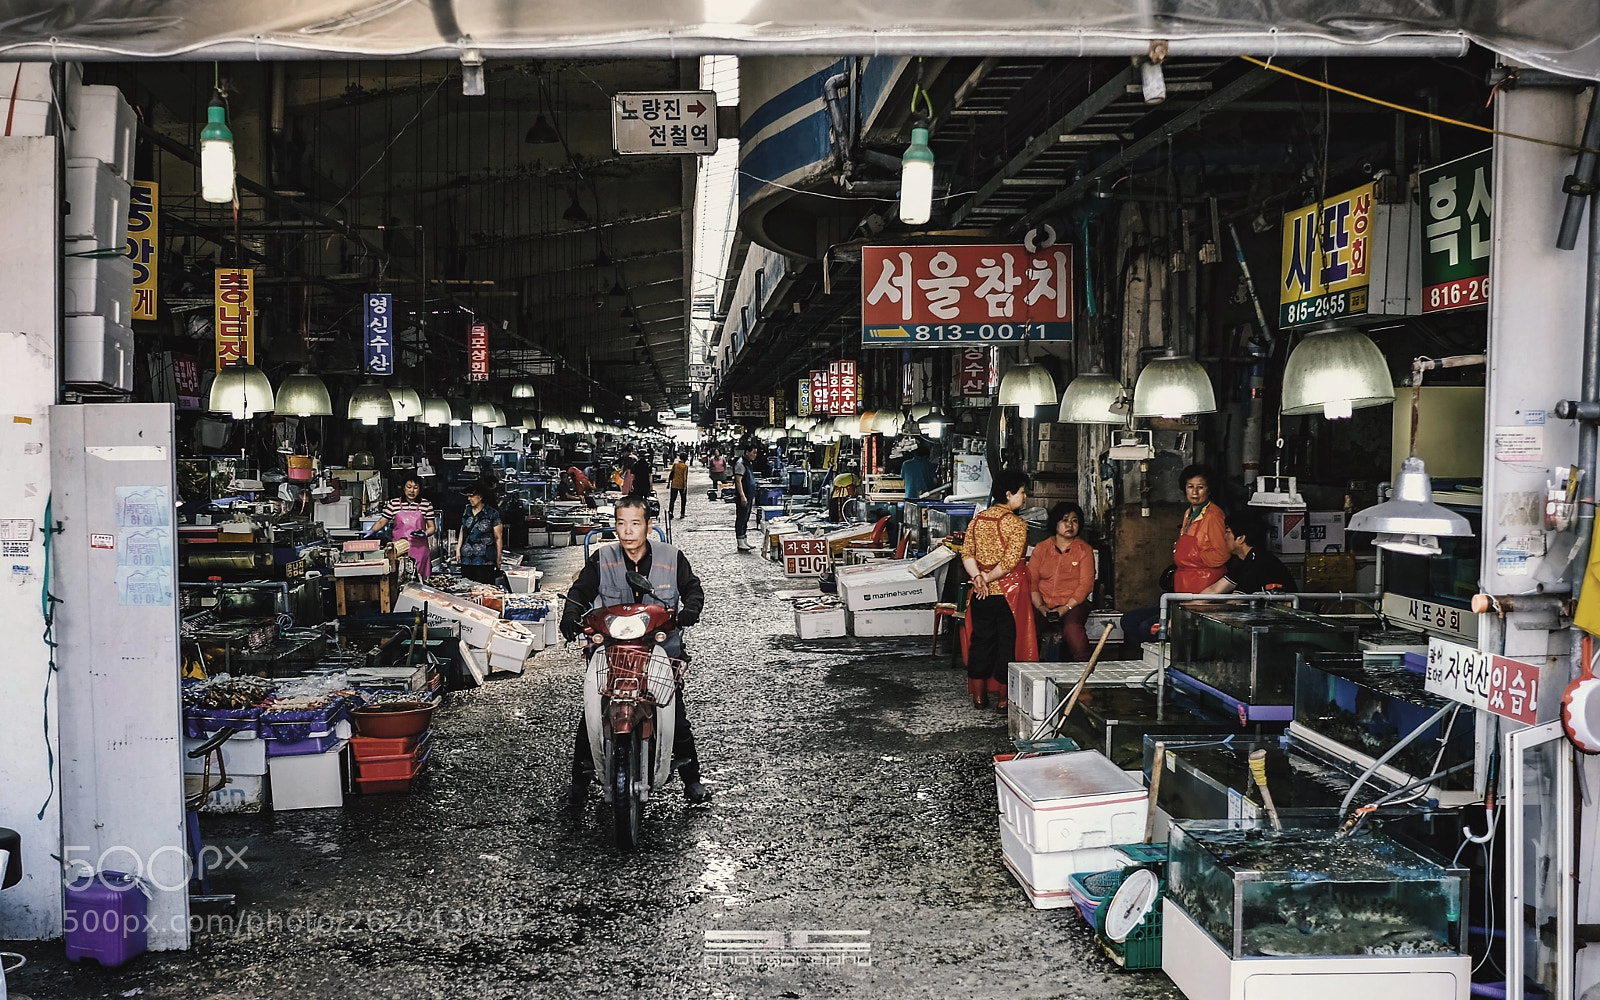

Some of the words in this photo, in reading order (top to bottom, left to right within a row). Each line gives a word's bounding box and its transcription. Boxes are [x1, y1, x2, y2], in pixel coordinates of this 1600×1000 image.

[621, 98, 681, 121] 노량진
[648, 123, 708, 147] 전철역
[1283, 199, 1351, 295] 사또
[1350, 192, 1371, 276] 상회
[866, 250, 1068, 321] 서울참치
[1287, 294, 1346, 324] 815-2955
[369, 296, 390, 372] 영신수산
[471, 325, 487, 372] 목포상회
[914, 323, 1047, 341] 813-0071
[812, 372, 829, 403] 신안
[829, 362, 840, 414] 대호수산
[840, 362, 855, 414] 대호수산
[786, 542, 826, 551] 자연산
[798, 556, 828, 574] 민어
[1408, 600, 1460, 633] 사또상회
[1426, 666, 1444, 684] 도다리
[1445, 651, 1489, 698] 자연산
